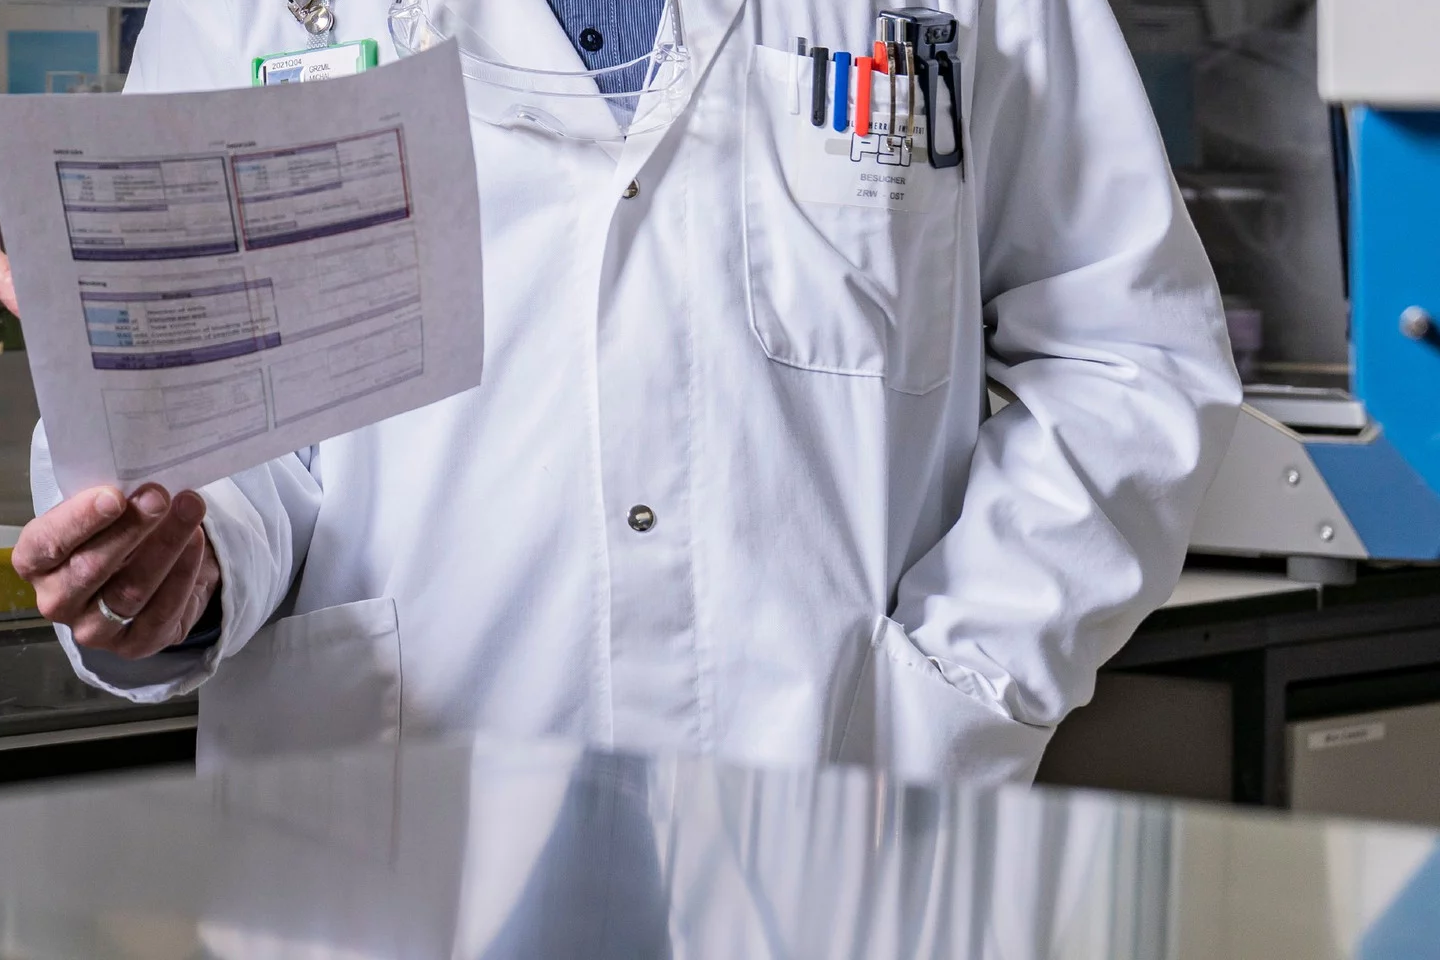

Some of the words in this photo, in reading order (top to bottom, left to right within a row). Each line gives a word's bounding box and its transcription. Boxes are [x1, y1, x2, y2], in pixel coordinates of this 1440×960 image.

[272, 58, 302, 70] 2021Q04
[860, 173, 906, 185] BESUCHER
[857, 188, 878, 197] ZRW
[890, 192, 905, 201] OST
